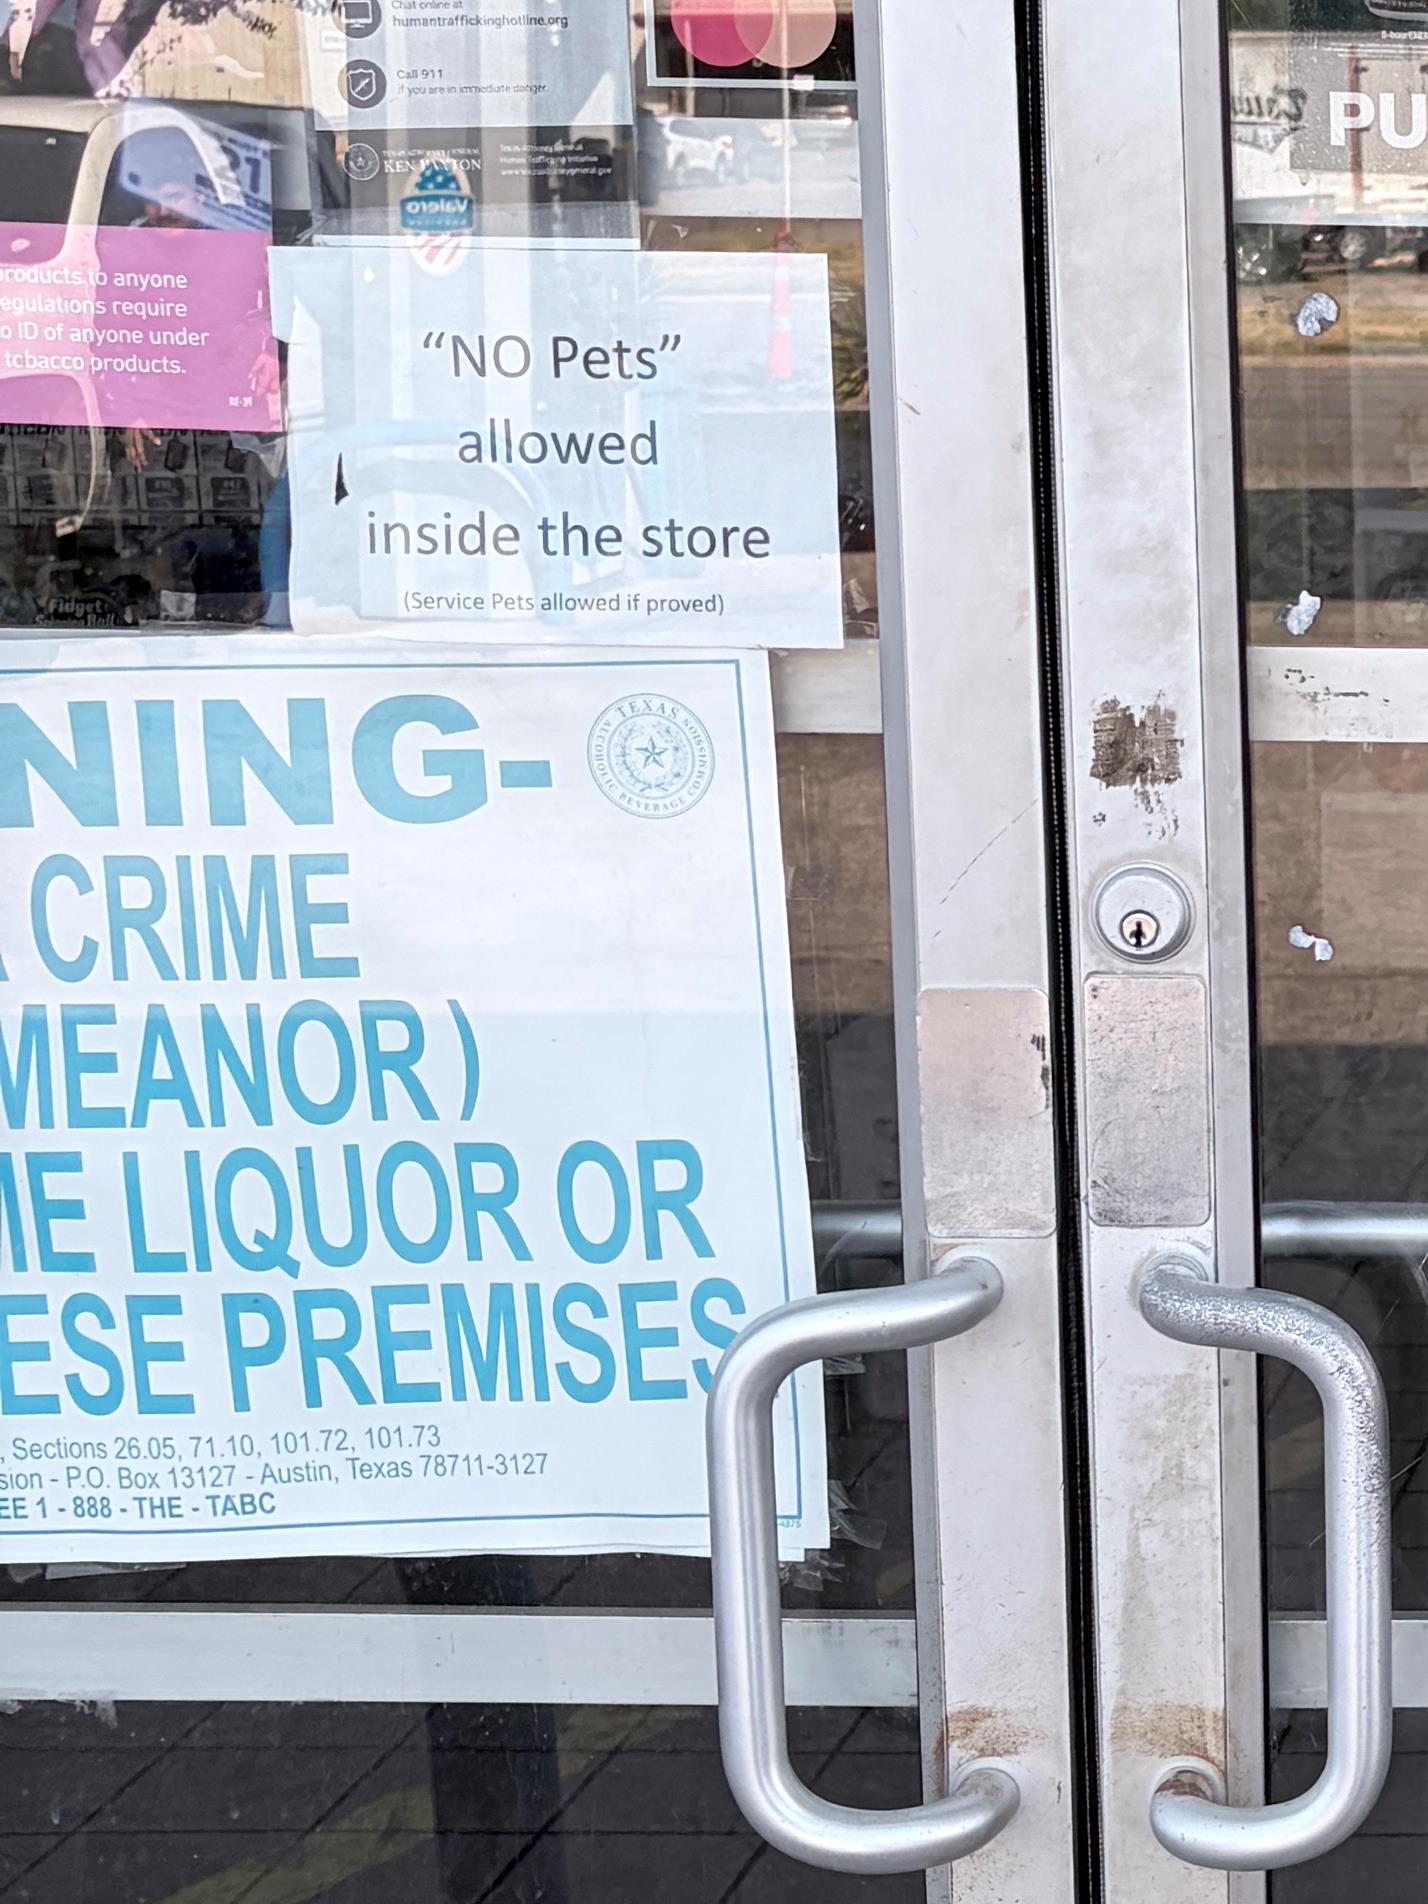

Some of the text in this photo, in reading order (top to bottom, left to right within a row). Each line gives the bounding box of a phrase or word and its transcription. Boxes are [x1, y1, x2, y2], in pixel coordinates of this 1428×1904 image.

[391, 0, 416, 11] Chat
[396, 69, 444, 80] Call 911
[383, 158, 416, 174] KEN
[113, 273, 188, 293] anyone
[112, 298, 188, 320] require
[18, 322, 38, 341] ID
[44, 323, 63, 341] of
[70, 329, 144, 348] anyone
[150, 327, 211, 347] under
[90, 354, 188, 375] products.
[457, 420, 660, 466] allowed
[367, 511, 773, 561] inside the store
[403, 589, 726, 618] (Service Pets allowed if proved)
[614, 699, 680, 719] TEXAS
[594, 719, 619, 793] ALCOHOLIC
[680, 717, 709, 797] COMMISSION
[618, 791, 686, 813] BEVERAGE
[29, 852, 361, 984] CRIME
[123, 1138, 534, 1279] LIQUOR
[555, 1139, 716, 1265] OR
[221, 1277, 760, 1414] PREMISES
[12, 1425, 441, 1462] Sections 26.05, 71.10, 101.72, 101.73
[66, 1466, 110, 1490] P.O.
[118, 1465, 160, 1490] Box
[168, 1464, 236, 1489] 13127
[261, 1459, 340, 1486] Austin,
[346, 1454, 413, 1480] Texas
[419, 1452, 549, 1478] 78711-3127
[73, 1495, 113, 1520] 888
[132, 1494, 184, 1519] THE
[206, 1492, 276, 1517] TABC
